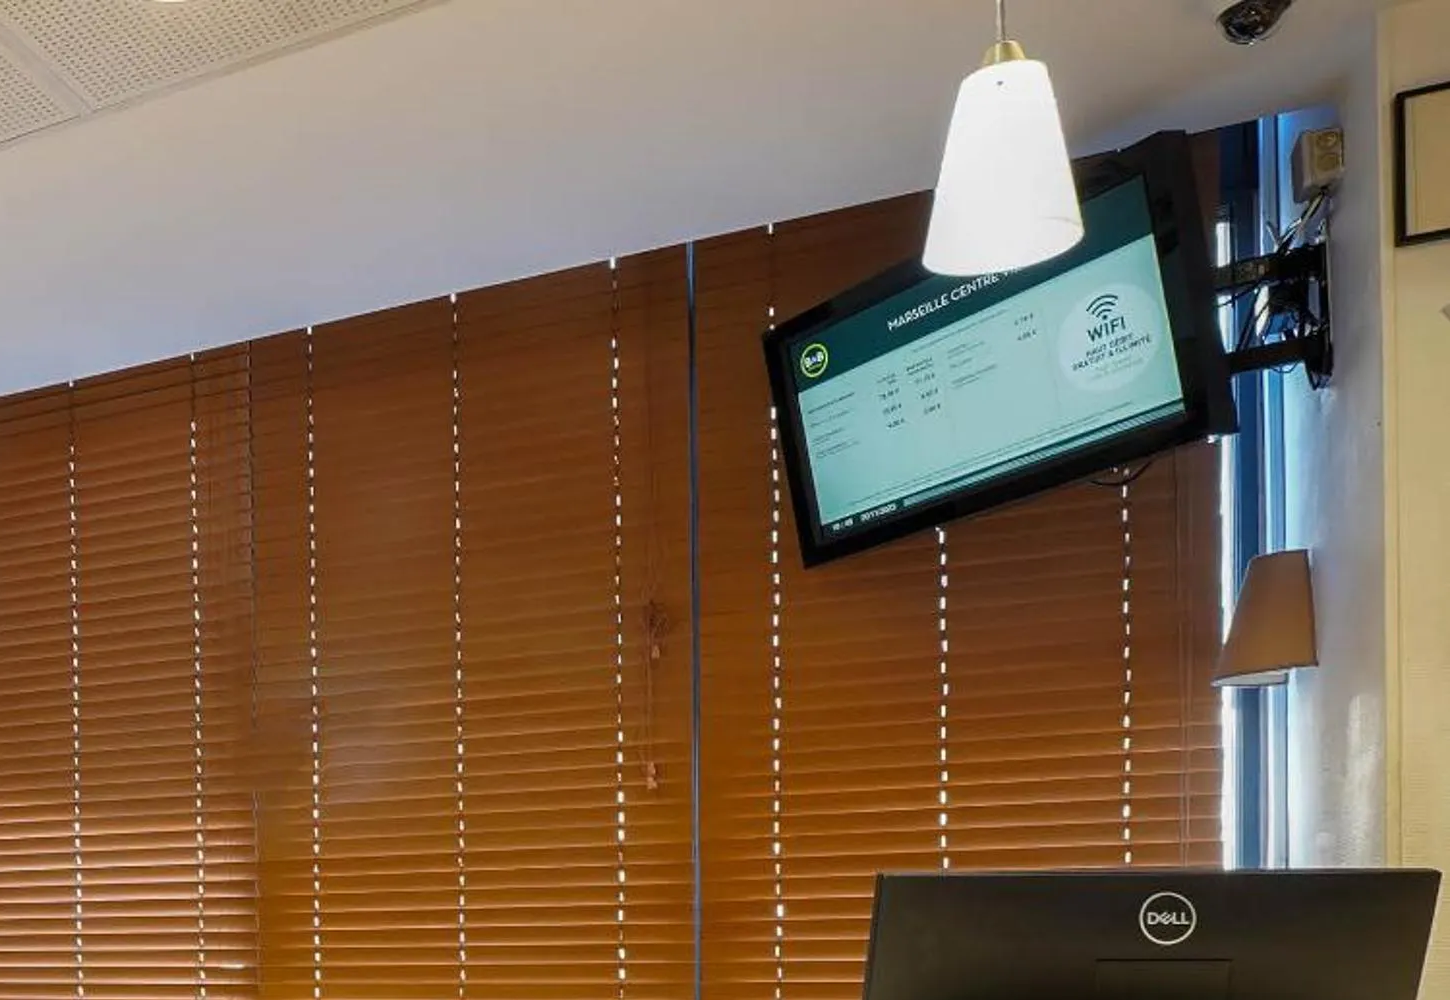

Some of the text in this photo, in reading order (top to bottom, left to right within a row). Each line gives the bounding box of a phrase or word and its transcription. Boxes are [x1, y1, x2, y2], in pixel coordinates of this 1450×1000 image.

[886, 293, 950, 331] MARSEILLE
[950, 272, 1000, 301] CENTRE
[1087, 316, 1126, 342] WIFI
[1147, 911, 1190, 925] DELL
